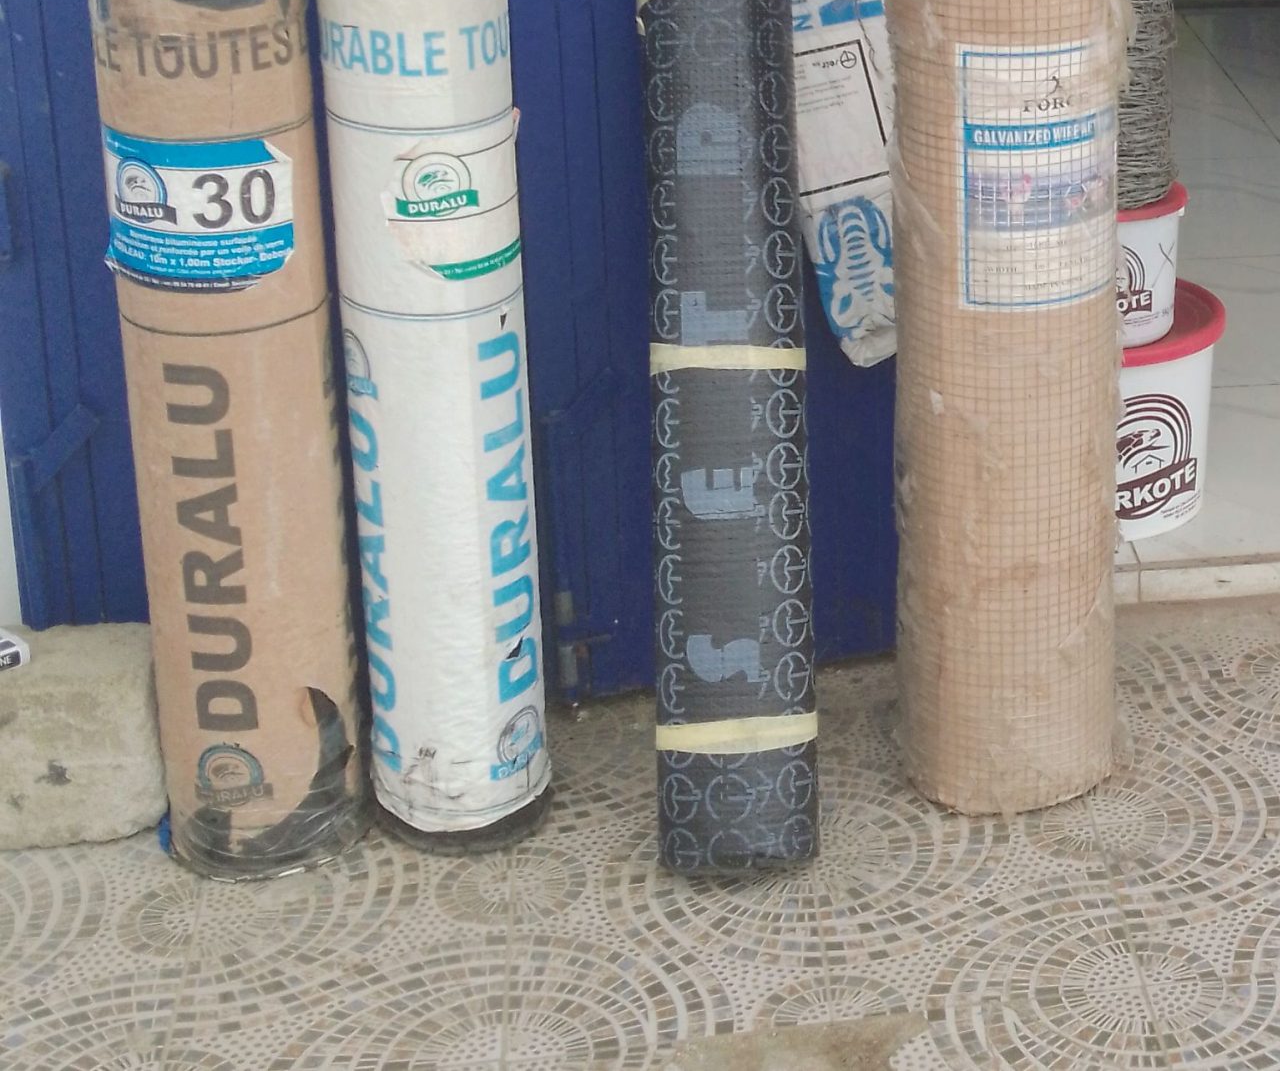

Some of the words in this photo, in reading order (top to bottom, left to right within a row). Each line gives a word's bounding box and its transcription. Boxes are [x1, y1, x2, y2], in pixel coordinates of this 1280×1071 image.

[133, 21, 295, 79] TOUTES
[974, 125, 1050, 146] GALVANIZED
[119, 201, 164, 220] DURALU
[192, 168, 277, 229] 30
[407, 193, 468, 215] DURALU
[478, 329, 541, 705] DURALU
[162, 362, 260, 731] DURALU
